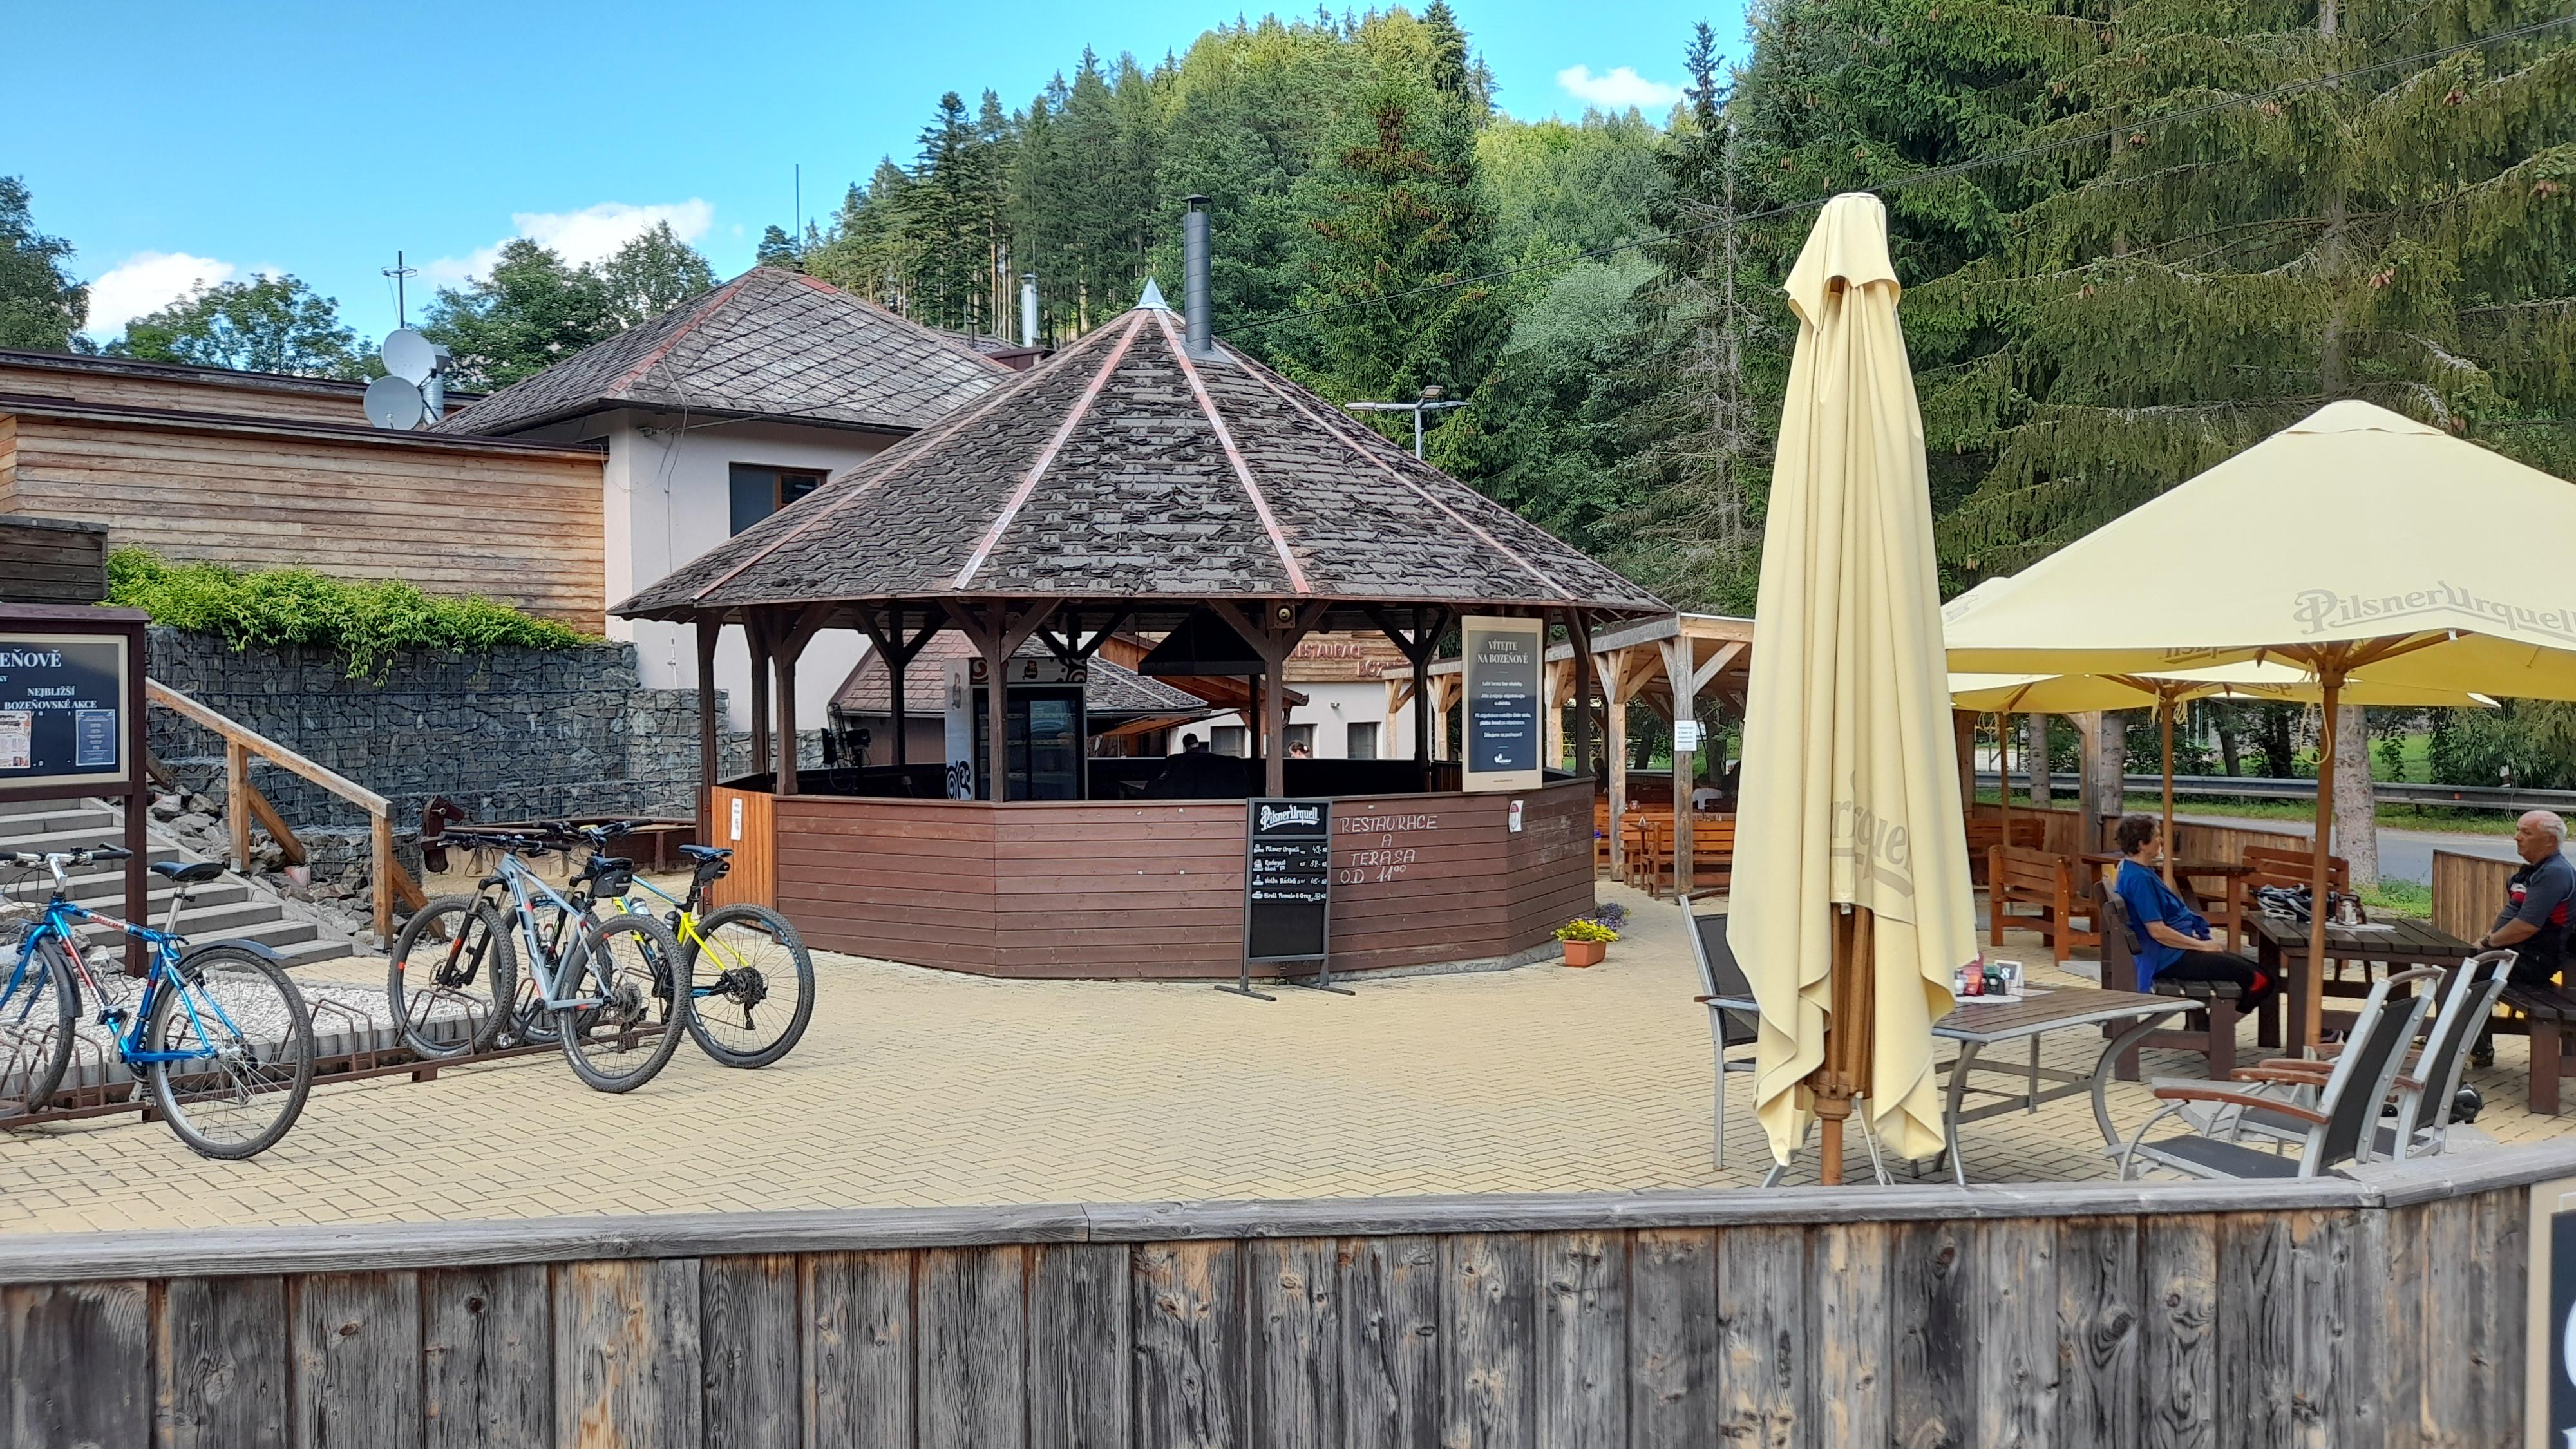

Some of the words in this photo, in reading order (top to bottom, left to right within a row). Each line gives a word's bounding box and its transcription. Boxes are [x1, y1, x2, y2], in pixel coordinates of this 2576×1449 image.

[2293, 589, 2445, 636] Pilsner
[1488, 638, 1518, 652] VÍTEJTE
[1477, 654, 1488, 663] NA
[1489, 652, 1528, 664] BOZEŇOVĚ
[27, 685, 75, 697] NEJBLIŽŠÍ
[5, 699, 70, 710] BOZEŇOVSKÉ
[72, 700, 97, 709] AKCE
[1260, 805, 1291, 831] Pilsner
[1340, 815, 1437, 833] RESTAURACE
[1381, 833, 1392, 848] A
[1350, 849, 1416, 866] TERASA
[1340, 869, 1365, 884] OD
[2000, 967, 2011, 980] 8
